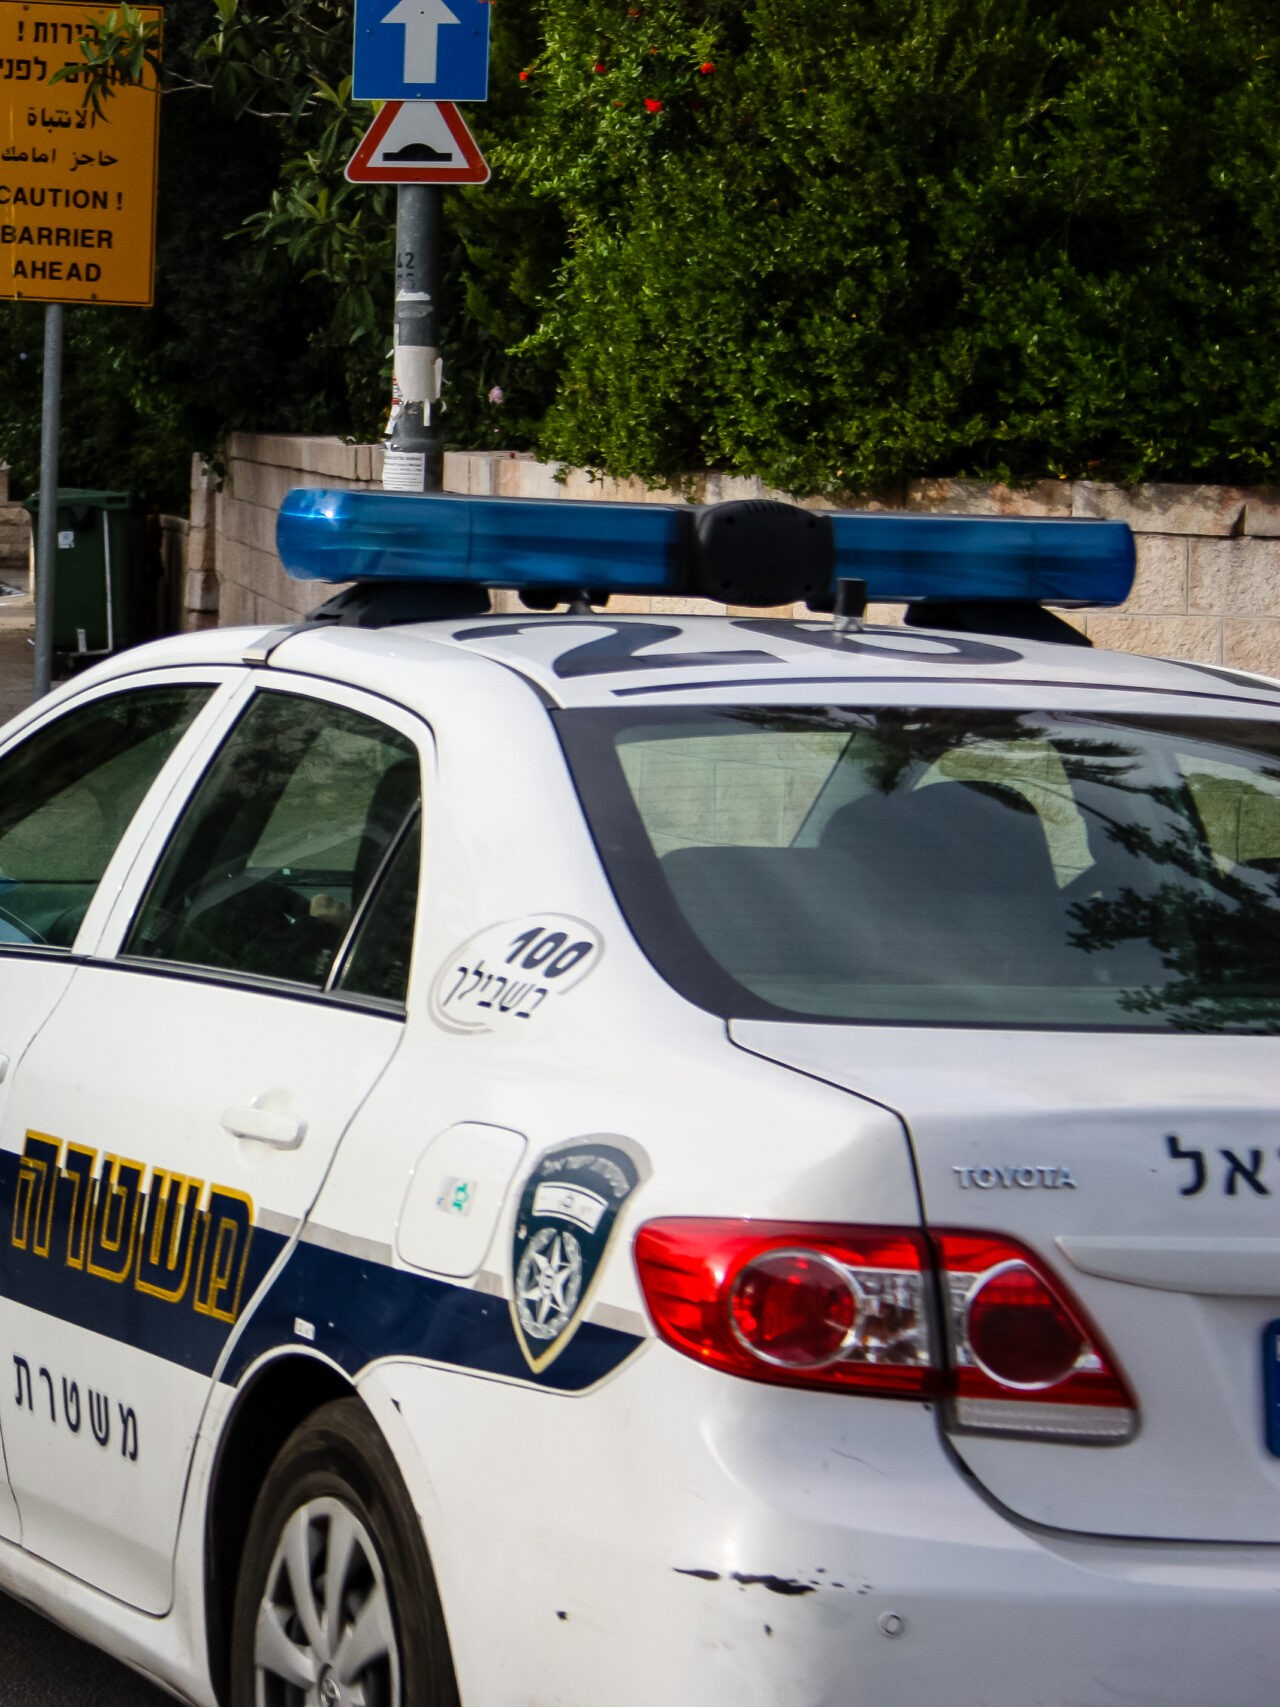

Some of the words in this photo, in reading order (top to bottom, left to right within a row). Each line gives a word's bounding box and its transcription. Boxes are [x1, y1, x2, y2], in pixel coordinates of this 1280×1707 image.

[33, 21, 110, 47] הירות
[69, 150, 118, 171] حاجز
[1, 224, 113, 249] BARRIER
[13, 260, 101, 282] AHEAD
[505, 927, 594, 978] 100
[442, 960, 548, 1019] בשבילך
[953, 1165, 1078, 1190] TOYOTA
[11, 1129, 255, 1325] משטרה
[13, 1353, 139, 1463] משטרת
